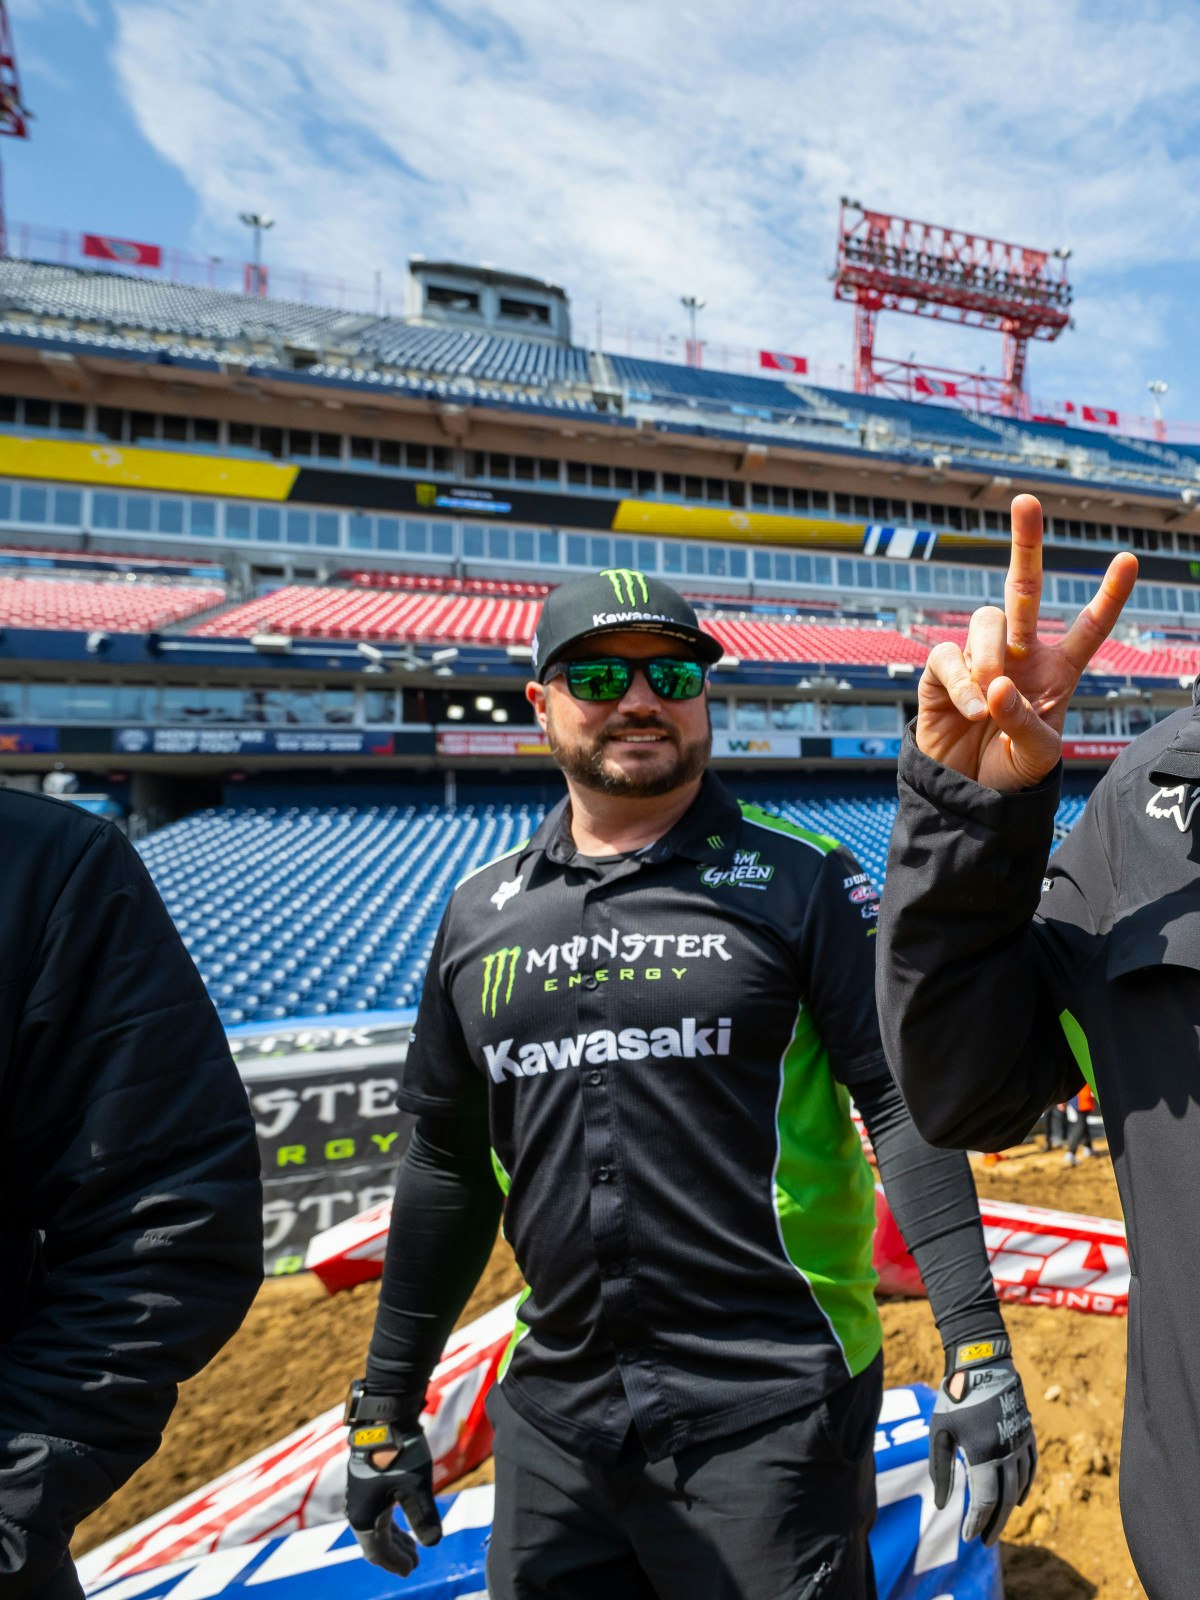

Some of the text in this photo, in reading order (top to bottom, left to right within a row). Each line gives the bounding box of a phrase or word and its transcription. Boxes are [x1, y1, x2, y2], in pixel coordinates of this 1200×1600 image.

[727, 740, 770, 752] WM
[703, 865, 771, 885] GREEN
[525, 928, 732, 974] MONSTER
[544, 967, 687, 992] ENERGY
[481, 1017, 732, 1084] Kawasaki
[993, 1283, 1115, 1312] ACING
